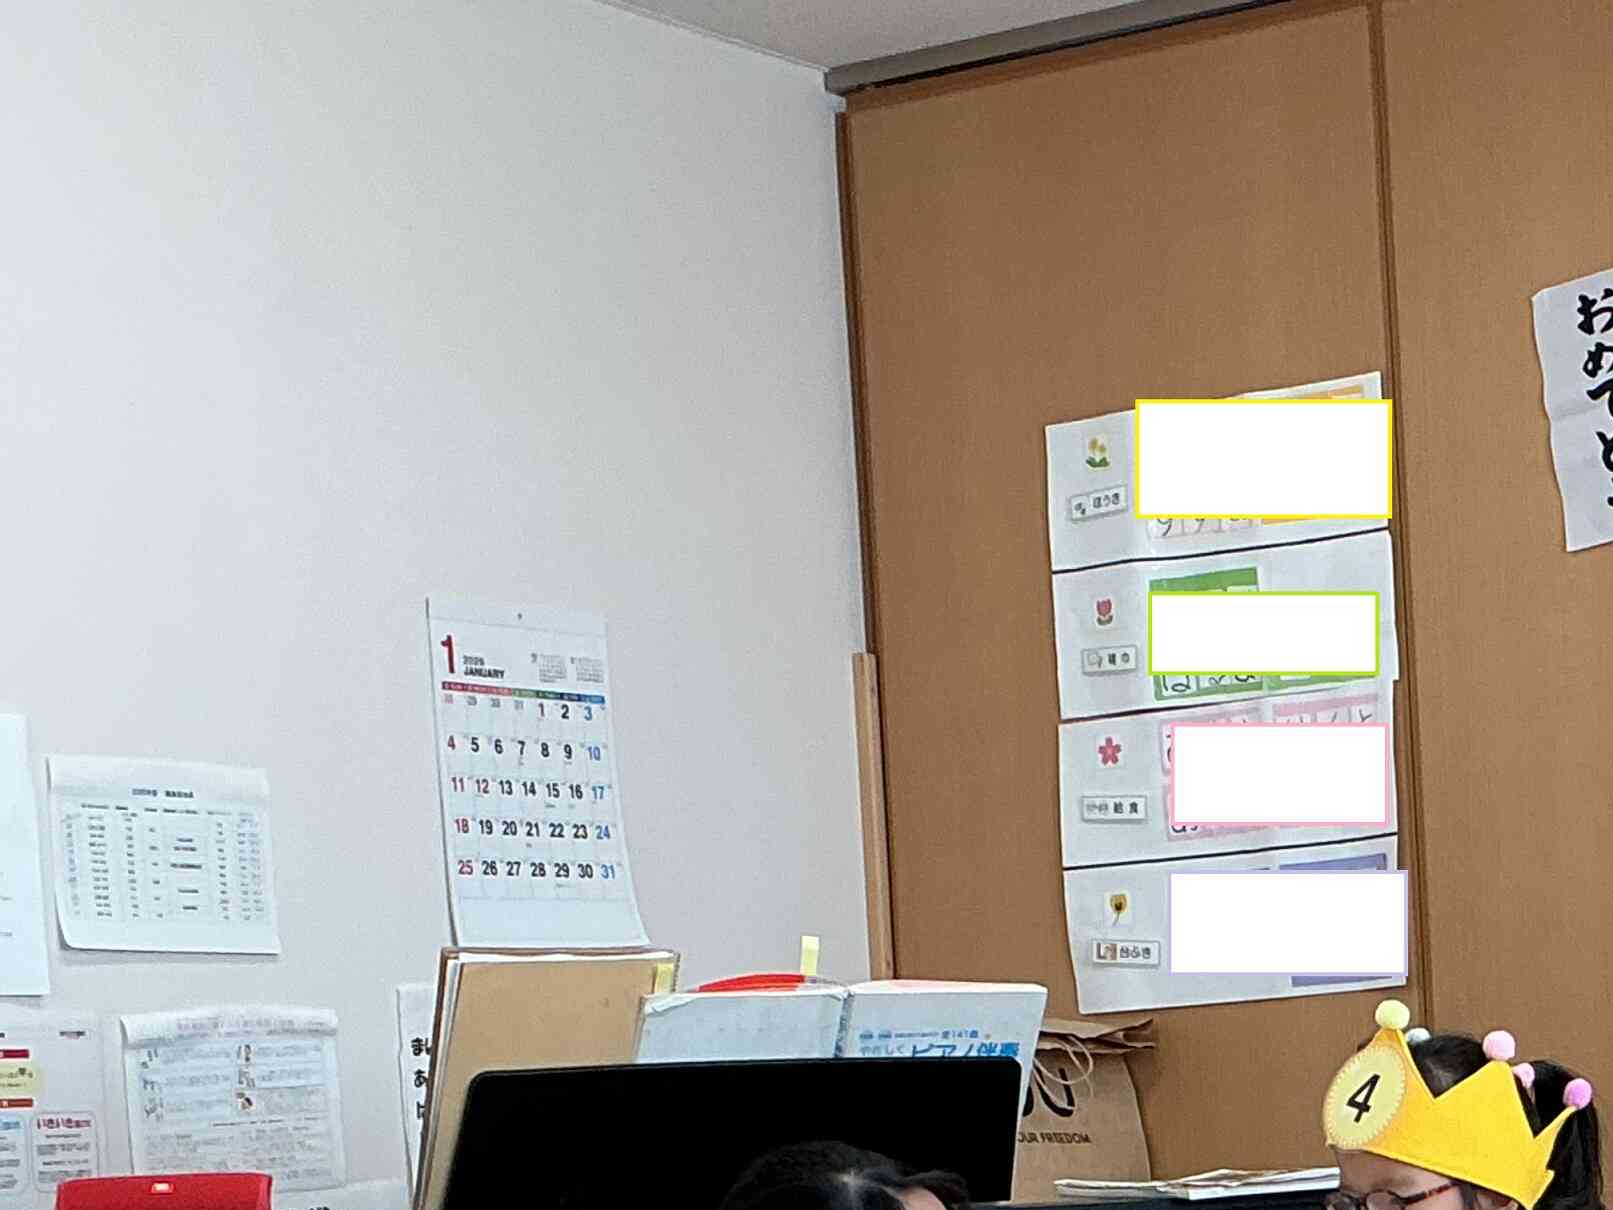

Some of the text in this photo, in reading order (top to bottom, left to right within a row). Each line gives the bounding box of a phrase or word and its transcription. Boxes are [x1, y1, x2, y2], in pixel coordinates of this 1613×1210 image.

[440, 634, 456, 674] 1
[463, 666, 505, 679] JANUARY
[538, 702, 545, 717] 1
[561, 703, 570, 720] 2
[584, 705, 593, 721] 3
[446, 735, 601, 761] 4 5 6 7 8 9 10
[451, 776, 605, 801] 11 12 13 14 15 16 17
[454, 818, 611, 841] 18 19 20 21 22 23 24
[457, 859, 616, 879] 25 26 27 28 29 30 31
[1348, 1074, 1380, 1123] 4
[1041, 1131, 1092, 1144] FREEDOM
